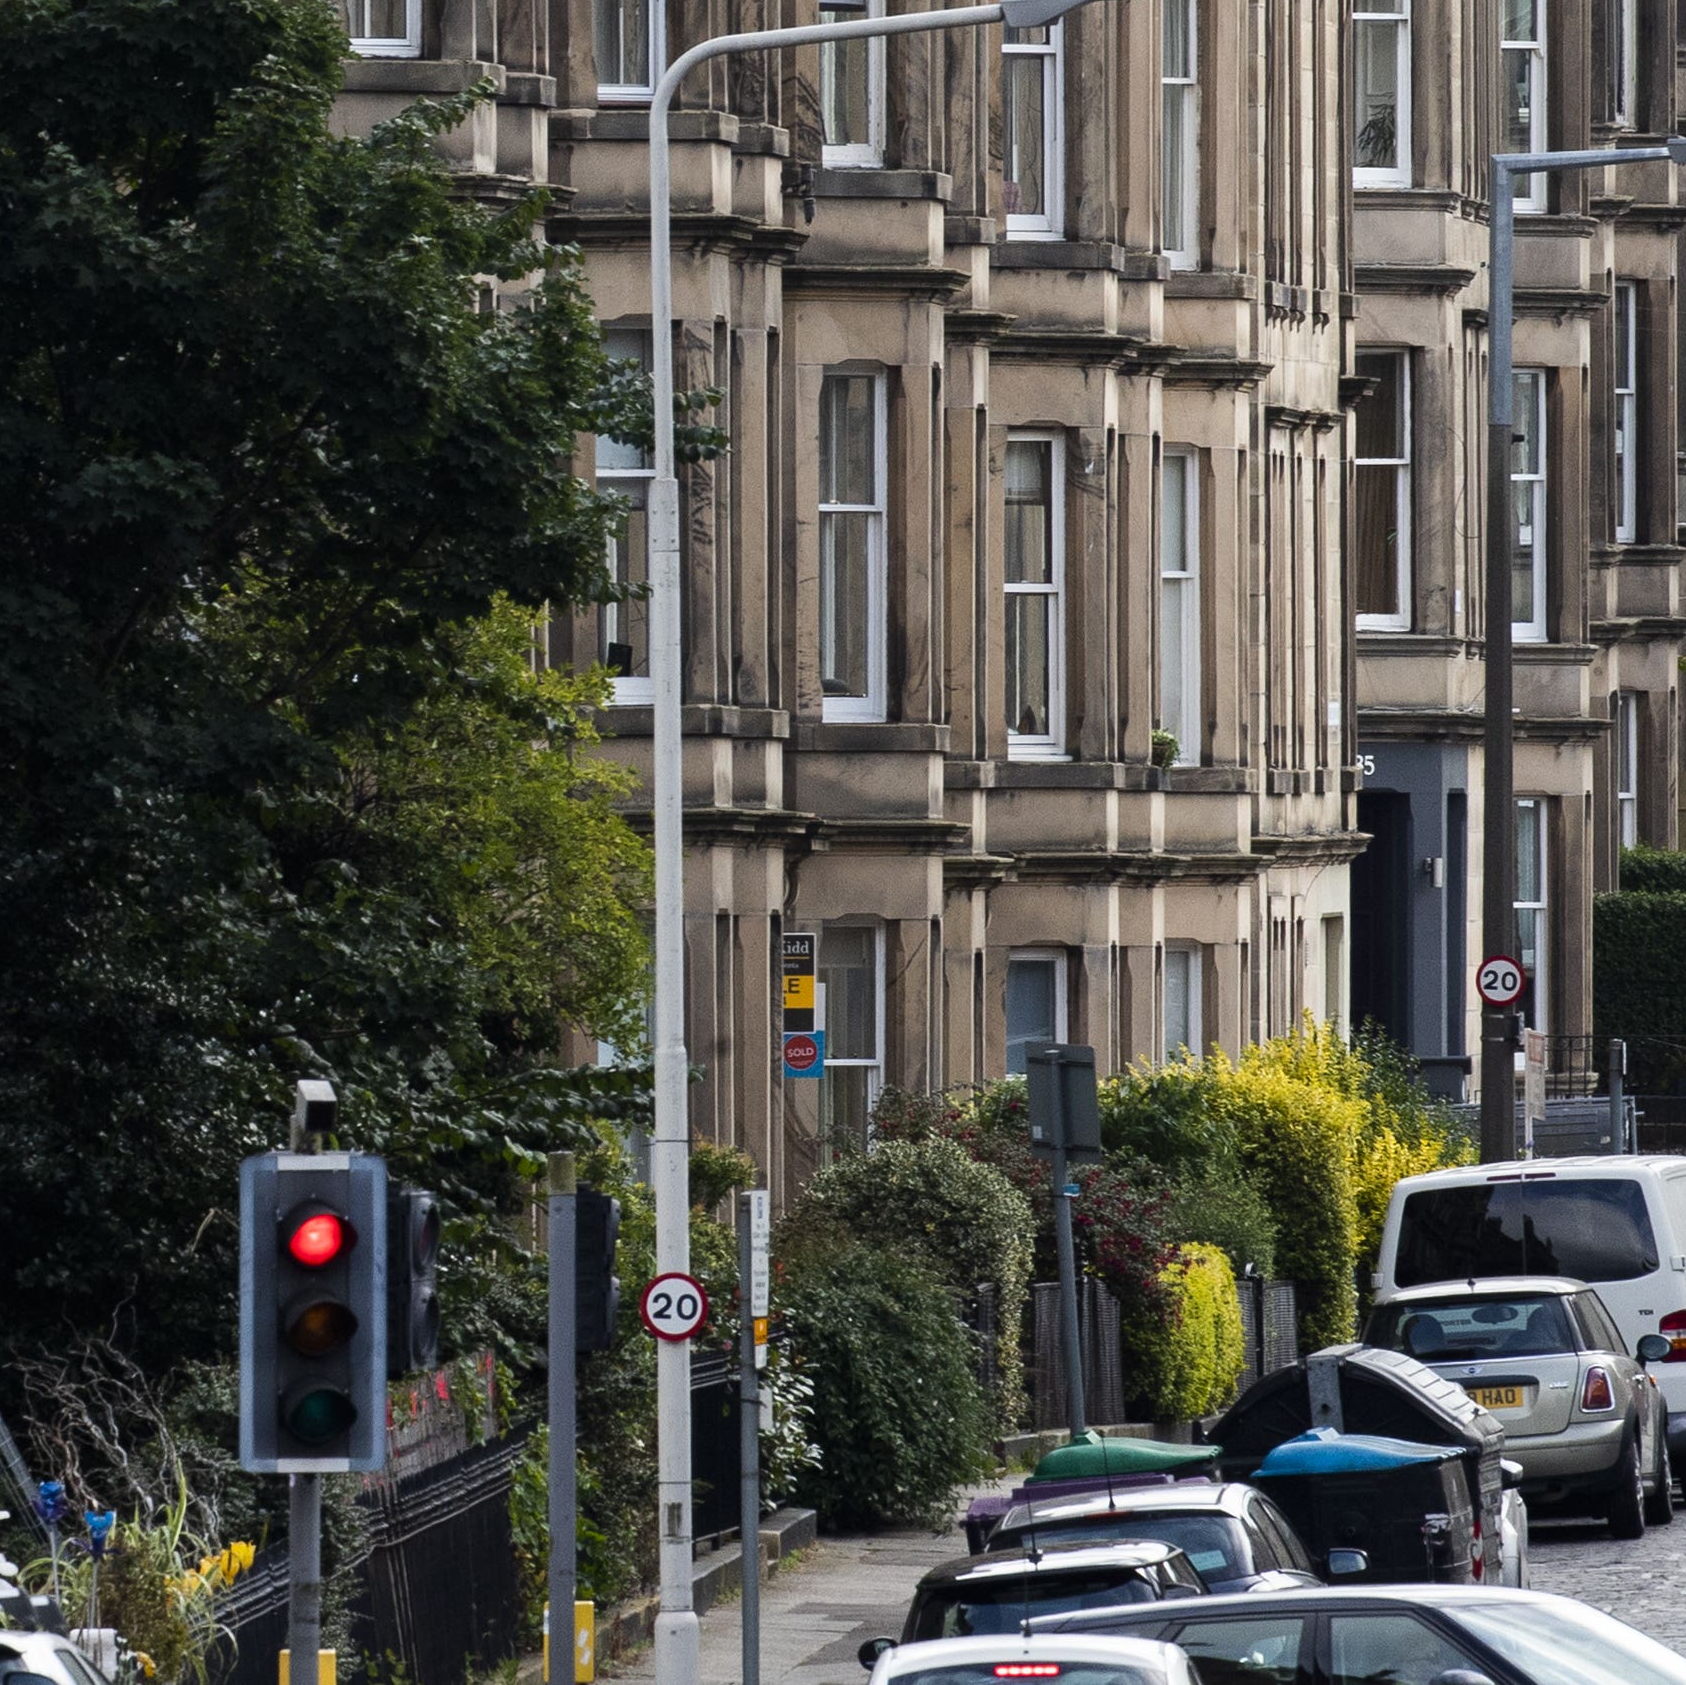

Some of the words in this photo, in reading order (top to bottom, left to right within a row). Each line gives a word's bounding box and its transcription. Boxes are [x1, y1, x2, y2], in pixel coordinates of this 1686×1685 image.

[1483, 970, 1518, 991] 20
[787, 1047, 815, 1058] SOLD
[652, 1292, 699, 1321] 20
